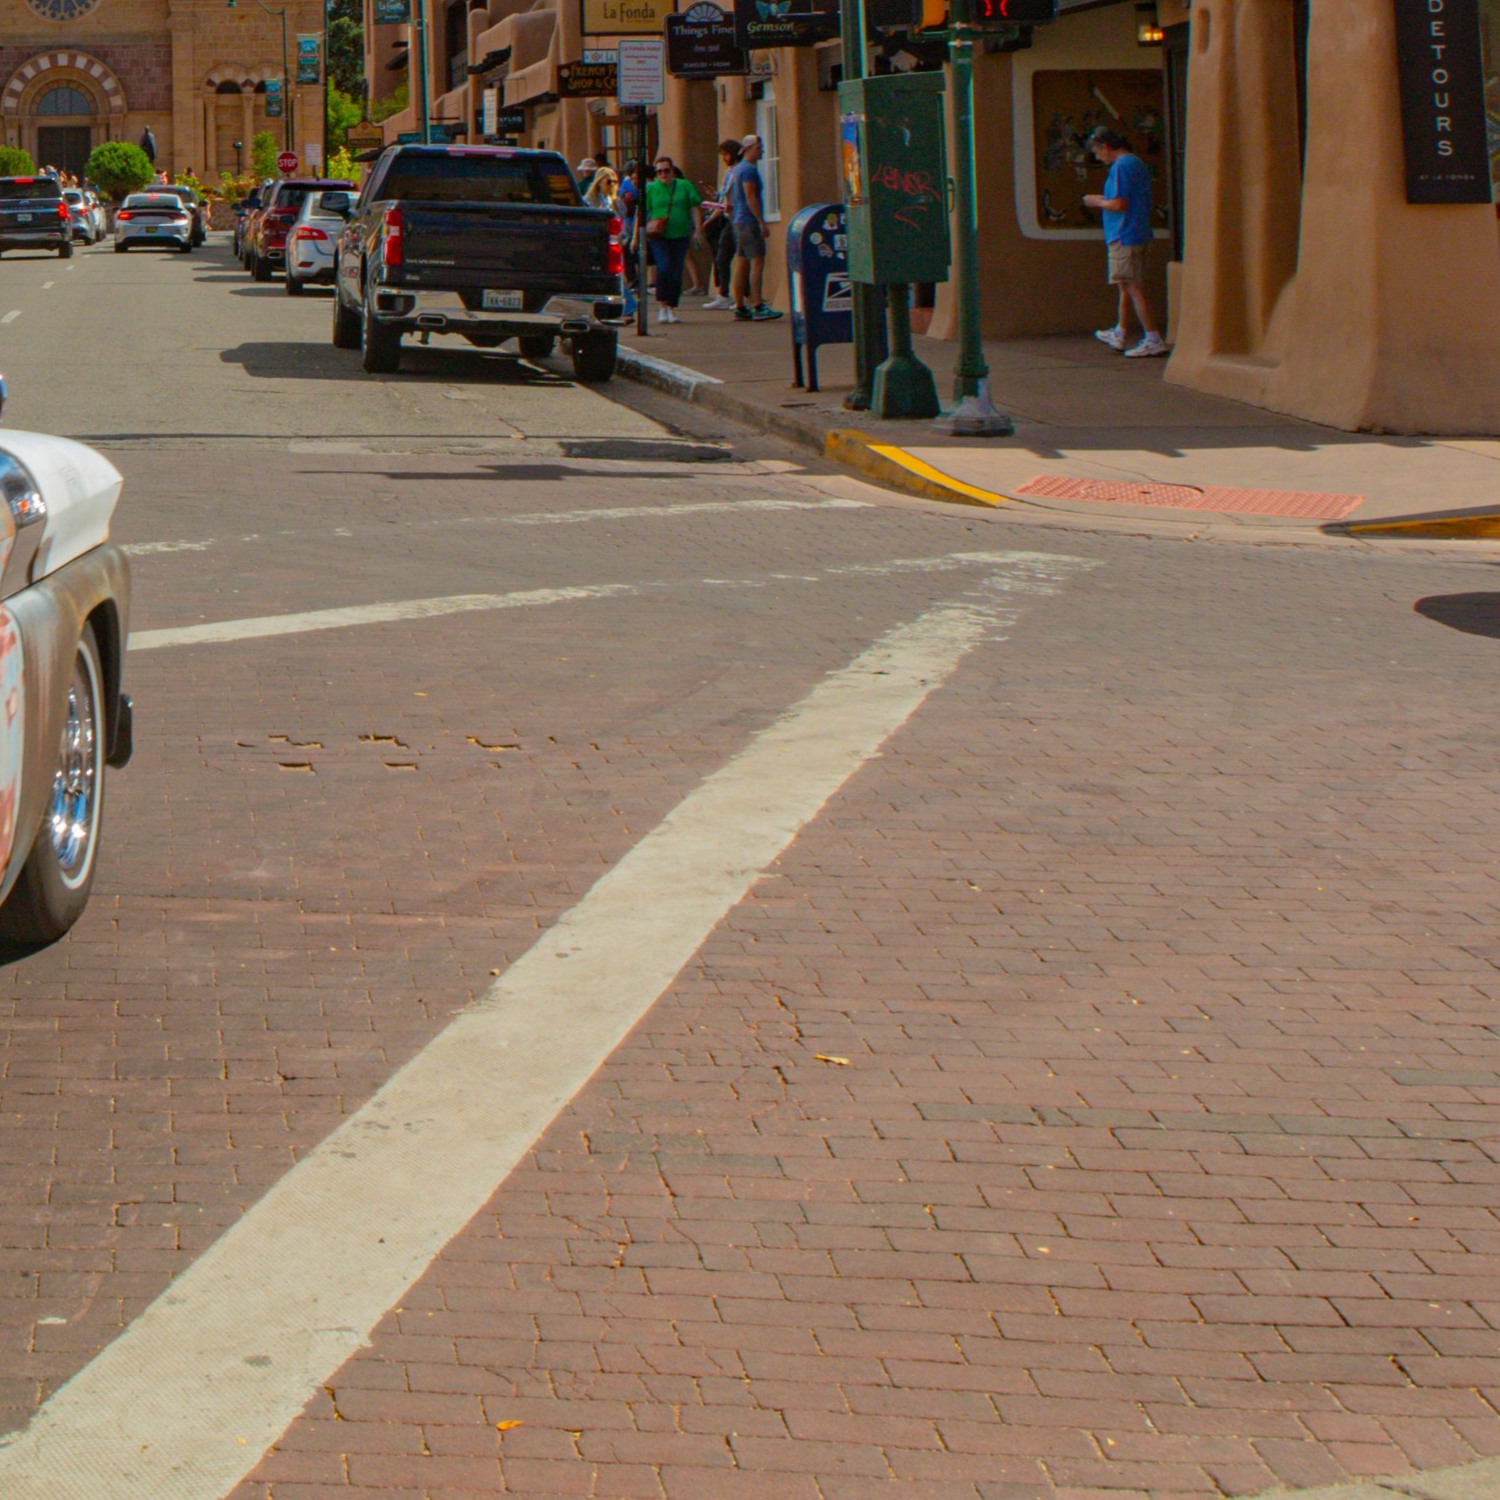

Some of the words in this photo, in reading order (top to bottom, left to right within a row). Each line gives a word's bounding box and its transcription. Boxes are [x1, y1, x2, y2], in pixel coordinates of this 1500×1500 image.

[603, 2, 617, 19] La
[620, 2, 655, 22] Fonda
[673, 25, 708, 38] Things
[567, 78, 593, 90] SHOP
[278, 157, 298, 167] STOP
